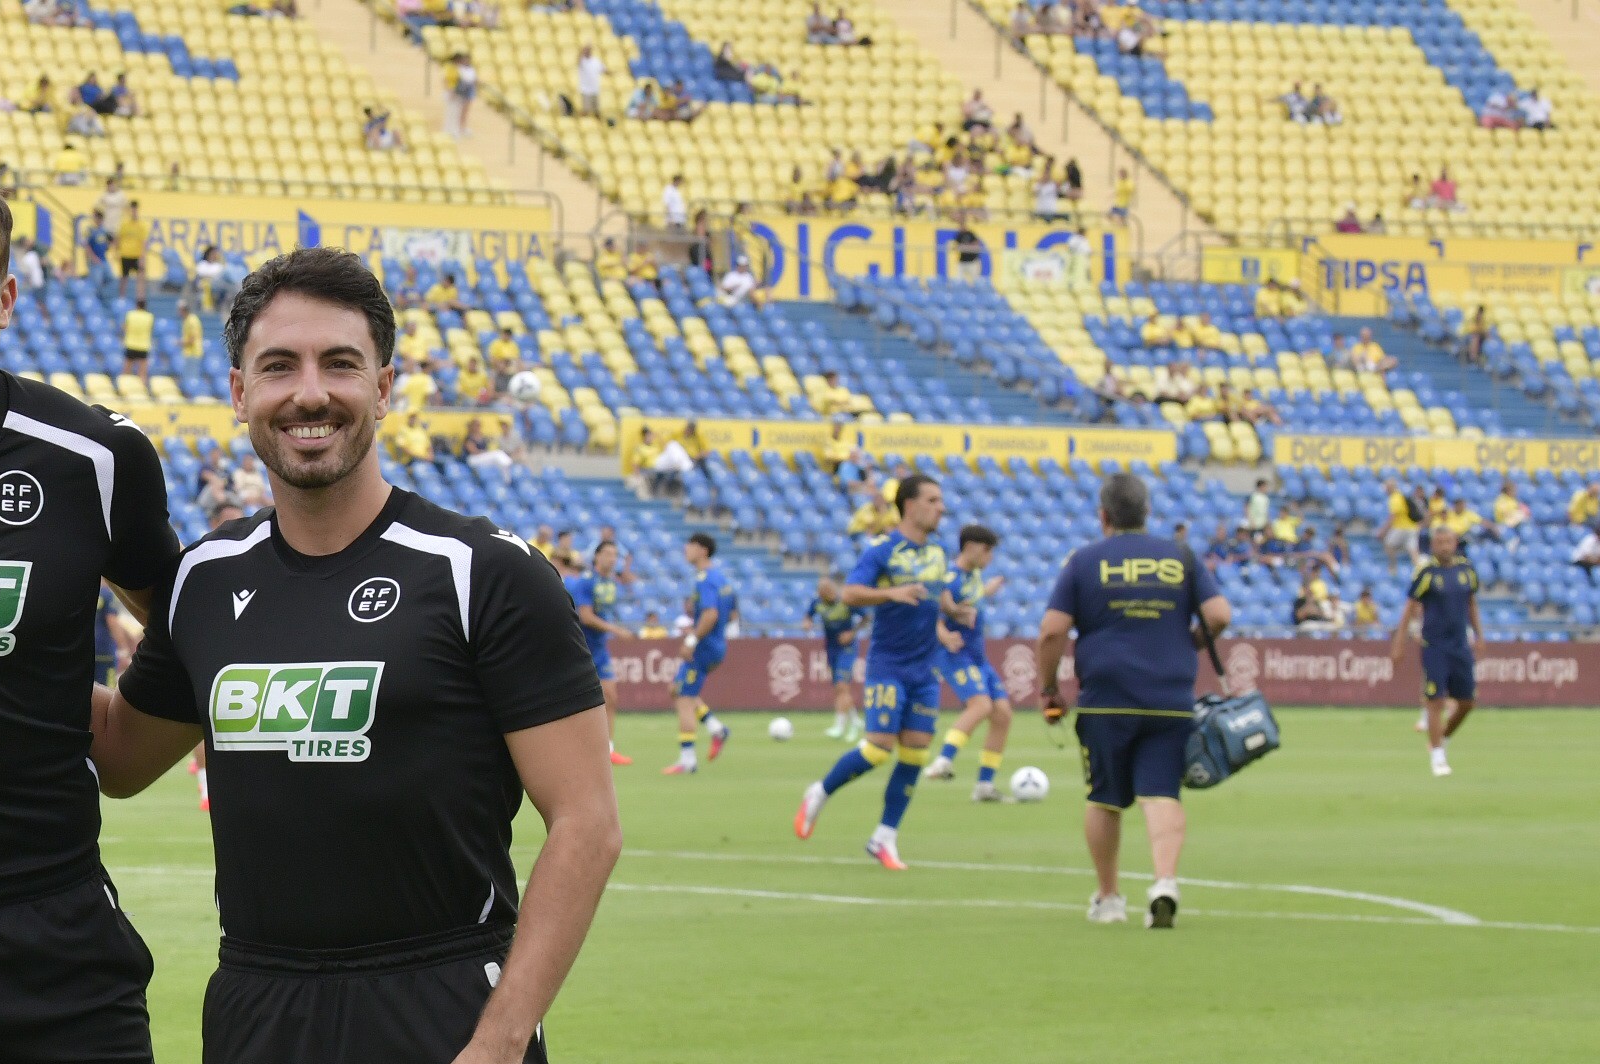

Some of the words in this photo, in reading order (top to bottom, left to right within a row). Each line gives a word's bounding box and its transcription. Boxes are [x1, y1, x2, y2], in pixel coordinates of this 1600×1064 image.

[1319, 257, 1428, 293] TIPSA
[1, 483, 32, 497] RF
[1, 499, 32, 512] EF
[1100, 557, 1185, 585] HPS
[362, 587, 392, 599] RF
[358, 600, 388, 612] EF
[1264, 648, 1337, 681] Herrera
[1339, 648, 1394, 688] Cerpa
[1526, 650, 1580, 689] Cerpa
[215, 679, 368, 720] BKT
[292, 739, 366, 757] TIRES
